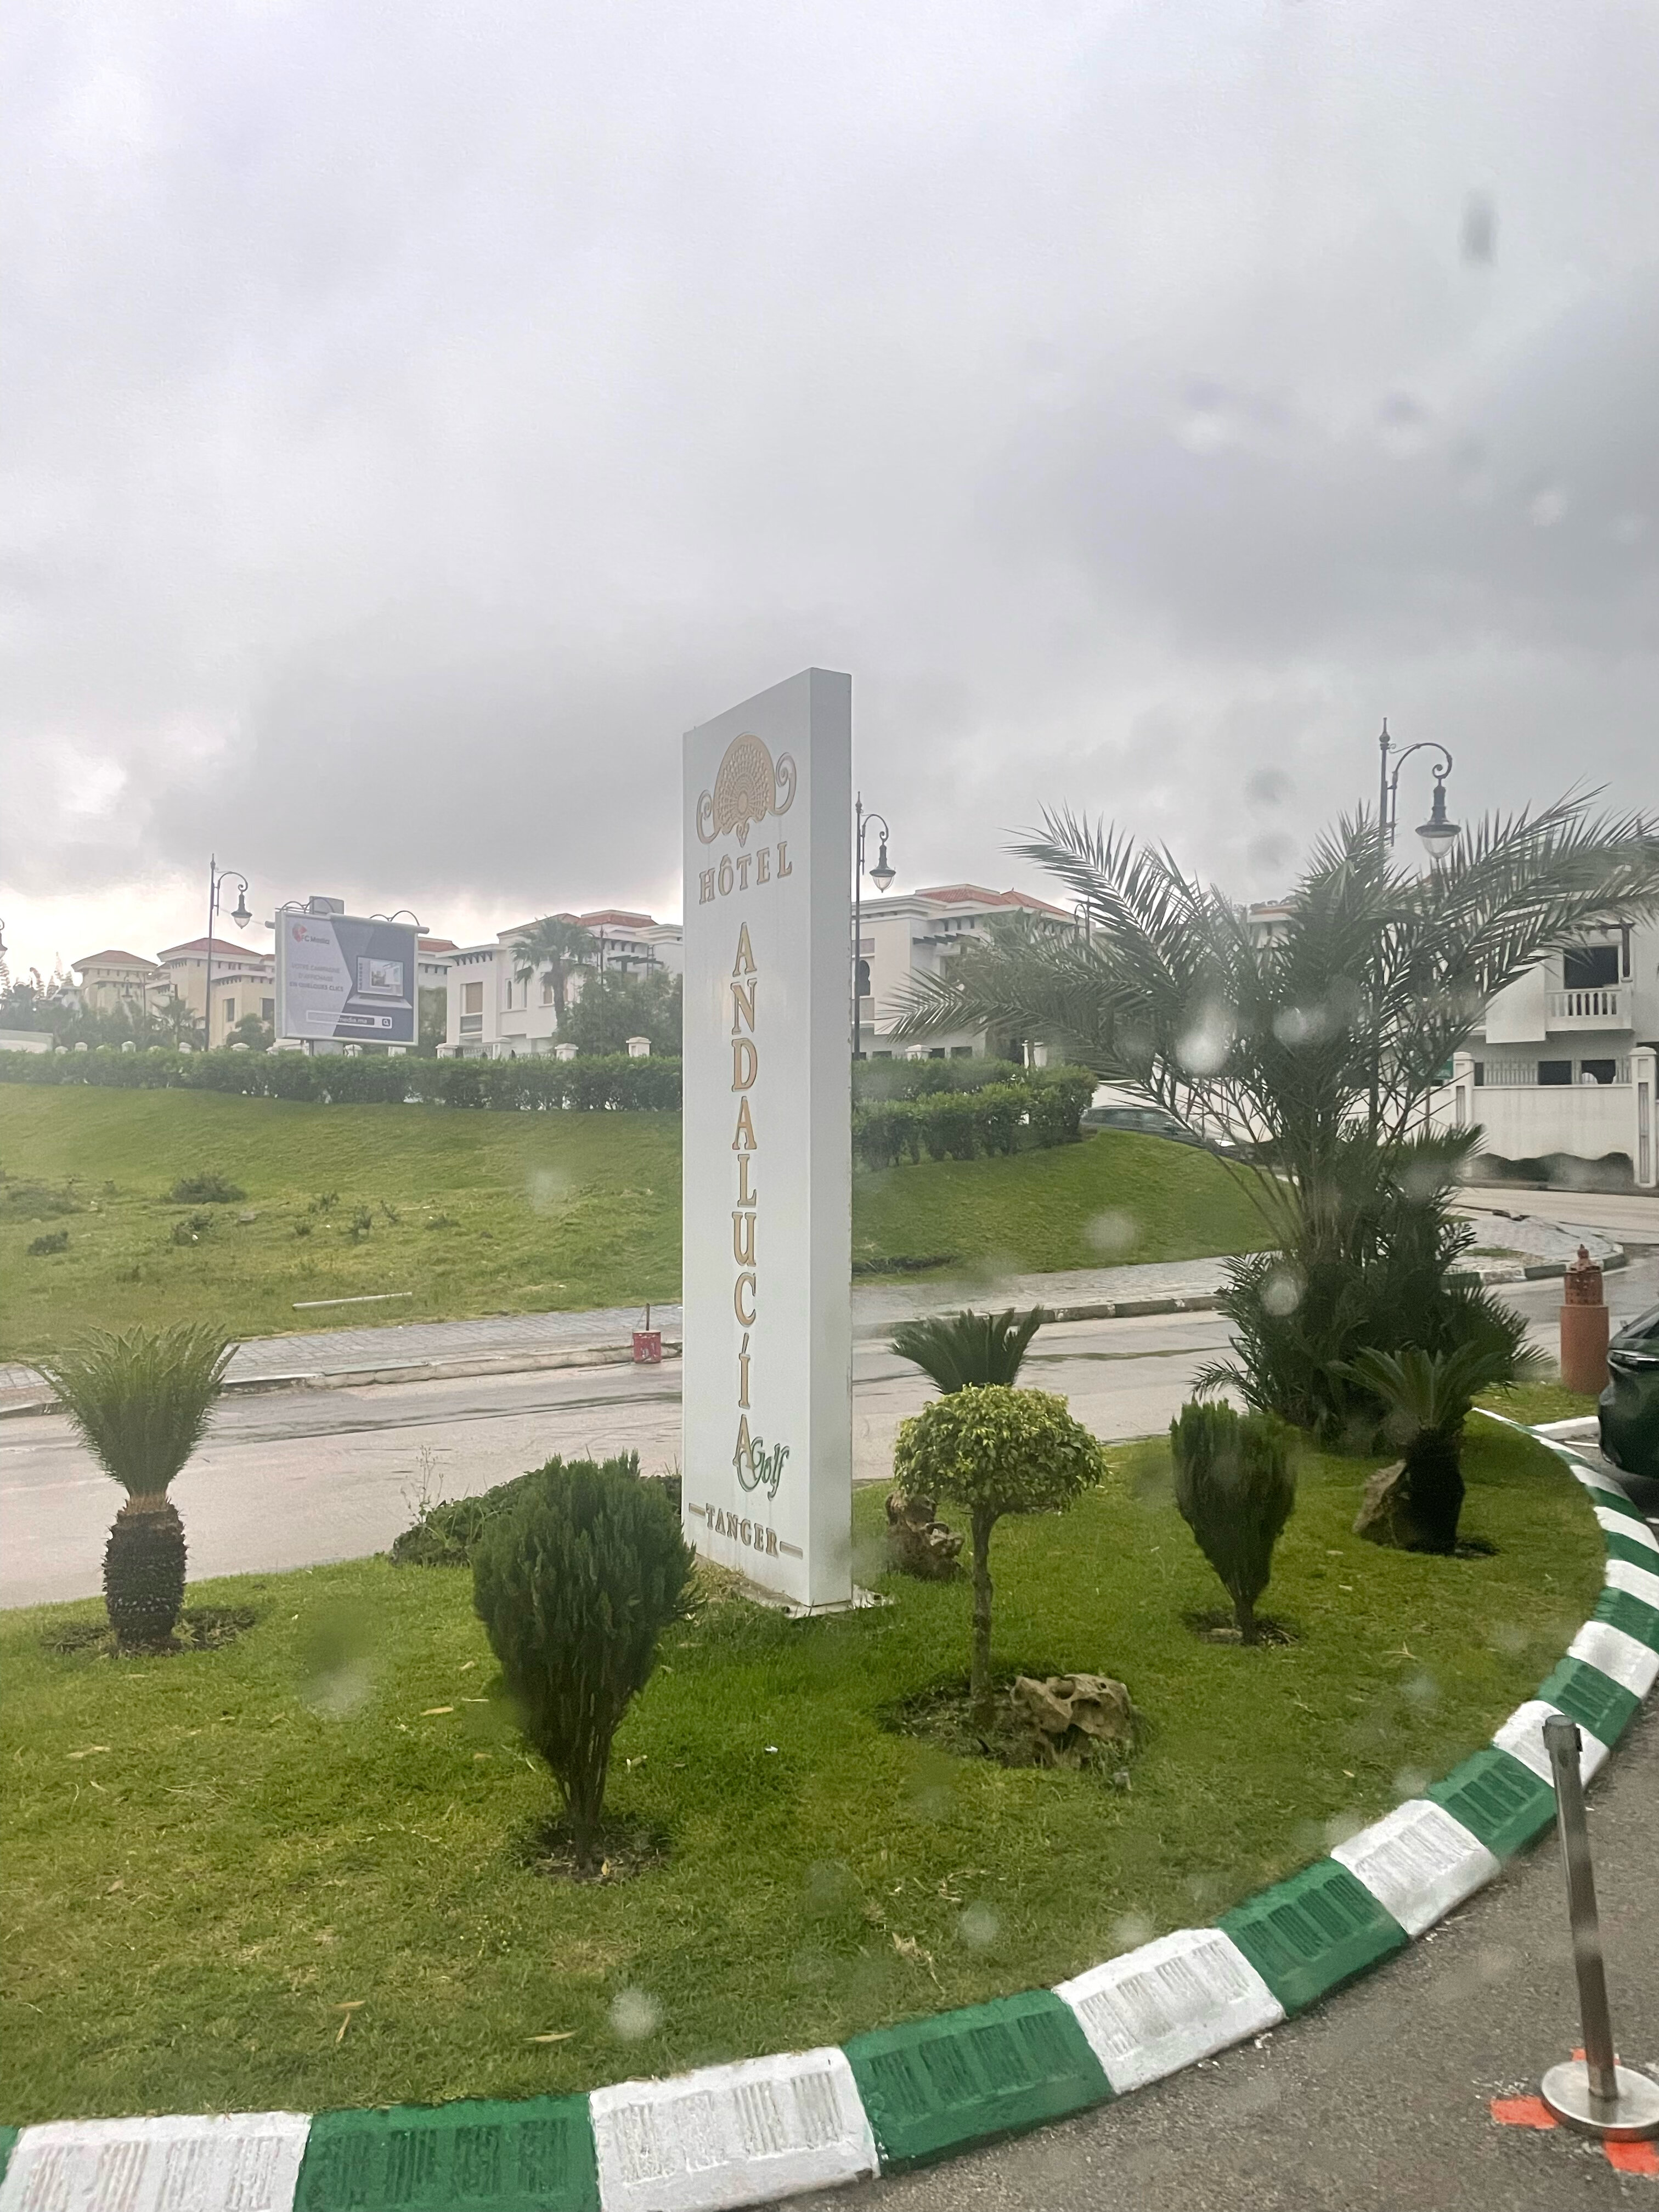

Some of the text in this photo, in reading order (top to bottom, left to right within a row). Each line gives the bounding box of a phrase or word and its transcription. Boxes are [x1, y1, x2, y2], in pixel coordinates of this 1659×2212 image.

[699, 840, 792, 905] HÔTEL
[736, 1436, 790, 1501] Golf
[706, 1503, 778, 1558] TANGER
